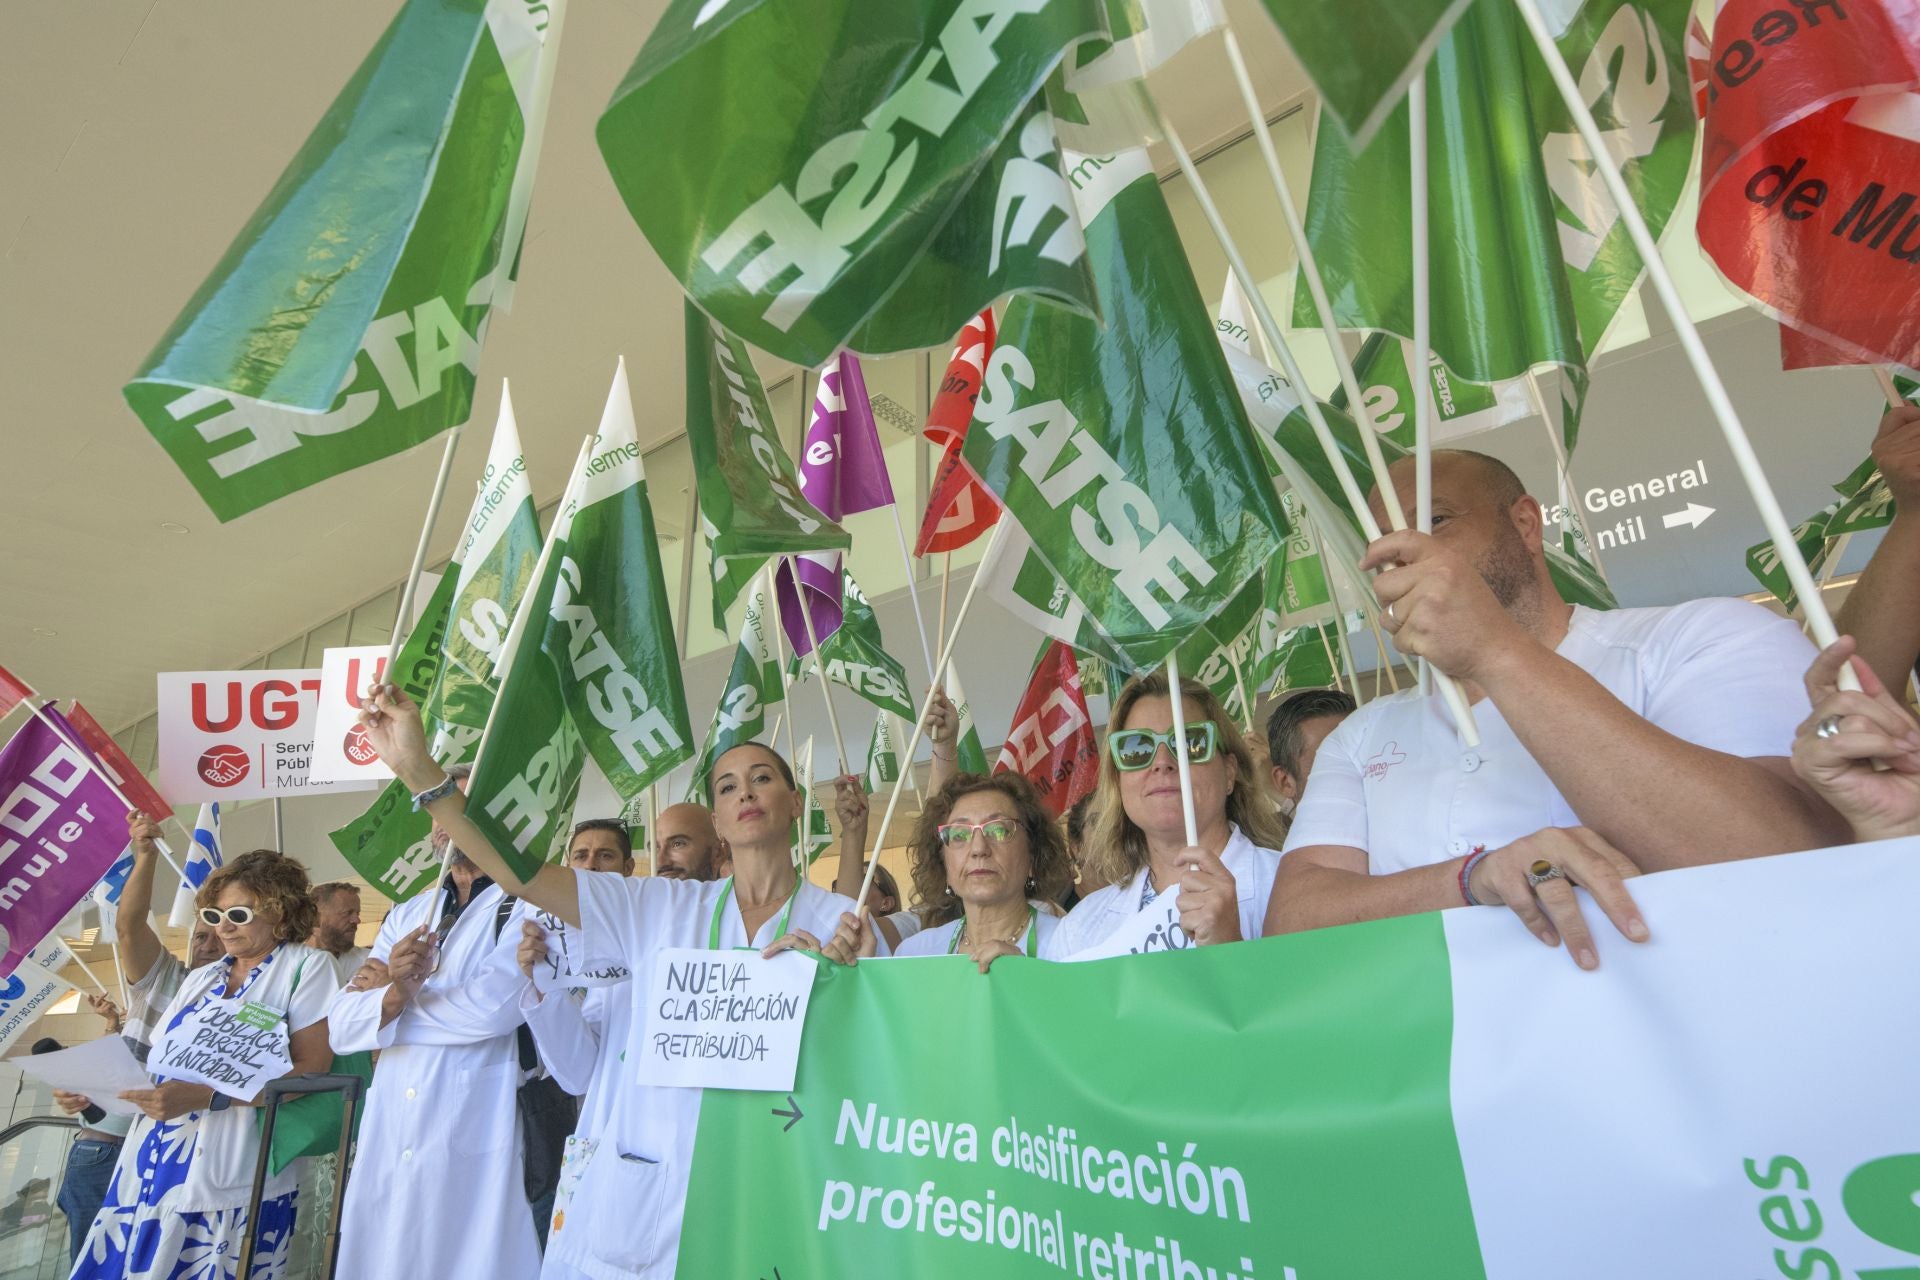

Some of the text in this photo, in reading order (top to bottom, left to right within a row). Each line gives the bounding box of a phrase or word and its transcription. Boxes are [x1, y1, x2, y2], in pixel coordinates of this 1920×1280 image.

[1745, 158, 1828, 222] de
[972, 344, 1218, 632] SATSE
[1585, 460, 1708, 513] General
[806, 658, 912, 711] ATSE
[276, 740, 314, 753] Servi
[0, 802, 96, 911] mujer
[666, 961, 752, 996] NUEVA
[158, 1039, 256, 1089] Y ANTICIPADA
[191, 1027, 264, 1070] PARCIAL
[653, 1032, 770, 1062] RETRIBUIDA
[834, 1098, 1252, 1224] Nueva clasificación
[818, 1178, 1067, 1271] profesional
